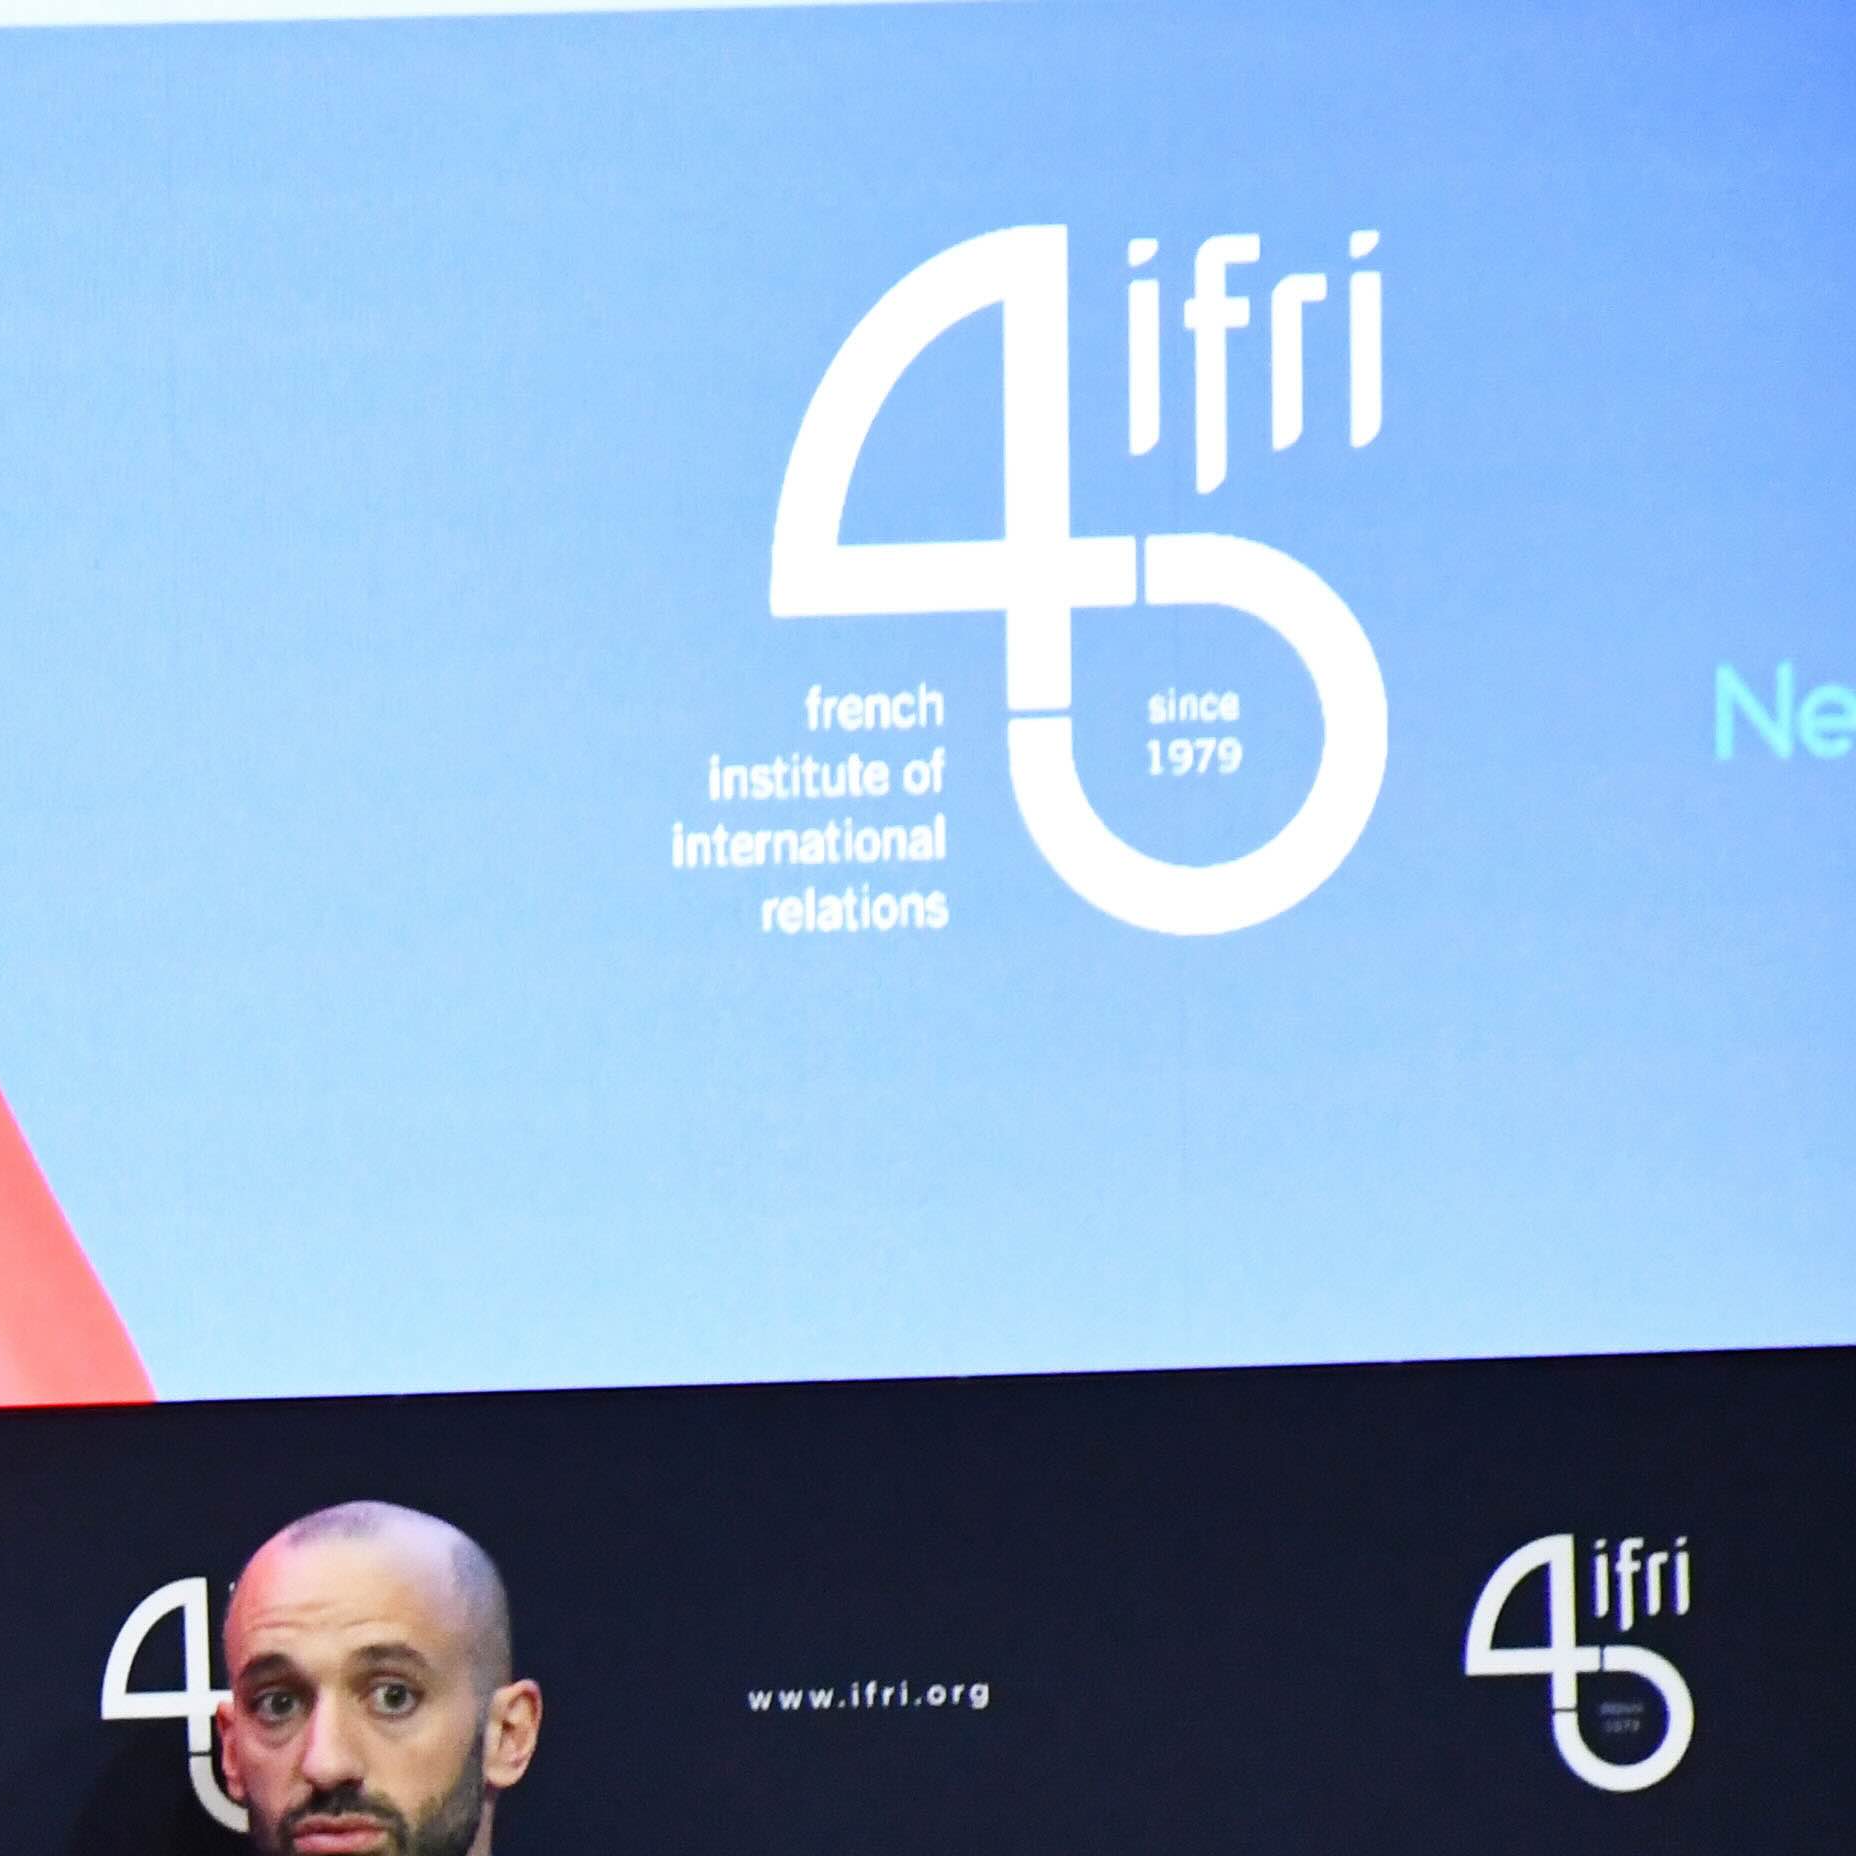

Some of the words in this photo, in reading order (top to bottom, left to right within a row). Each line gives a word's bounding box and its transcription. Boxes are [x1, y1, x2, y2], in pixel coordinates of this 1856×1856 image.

[1128, 230, 1383, 494] ifri
[805, 684, 945, 731] french
[1148, 688, 1240, 724] since
[708, 753, 890, 801] institute
[902, 748, 946, 796] of
[1148, 738, 1243, 777] 1979
[672, 814, 946, 868] international
[761, 886, 950, 935] relations
[1593, 1535, 1690, 1632] ifri
[747, 1679, 991, 1712] www.ifri.org
